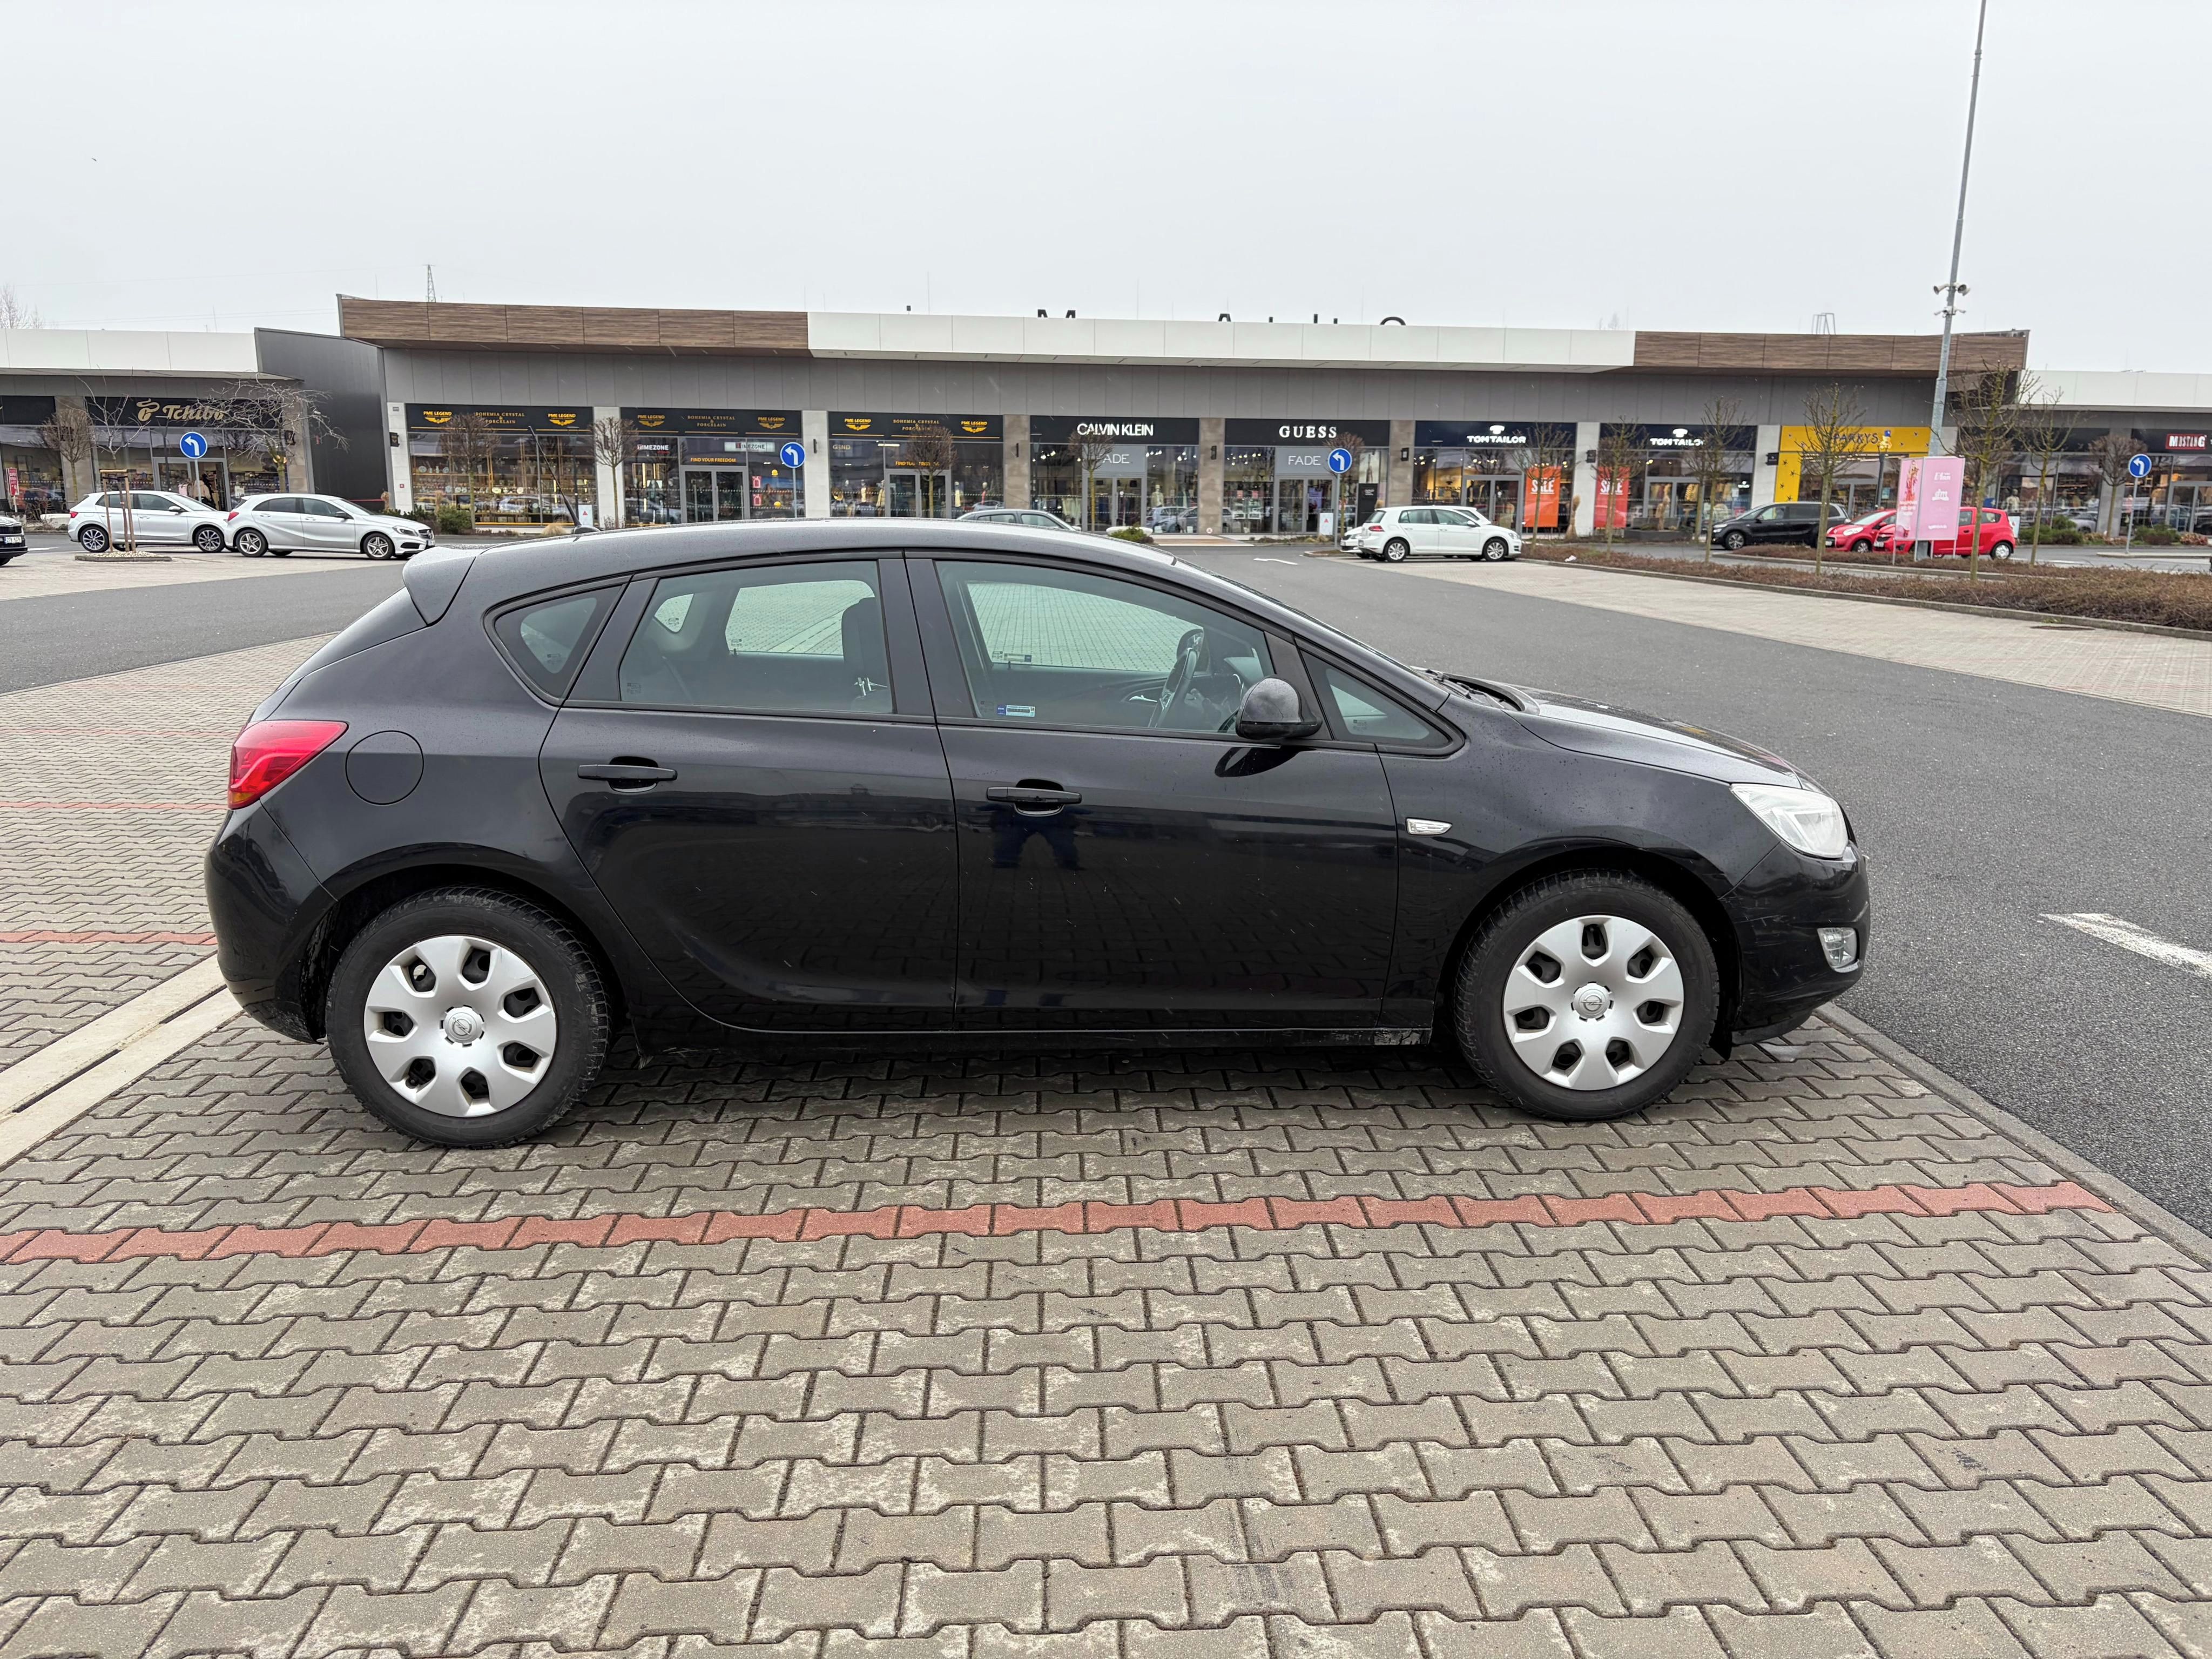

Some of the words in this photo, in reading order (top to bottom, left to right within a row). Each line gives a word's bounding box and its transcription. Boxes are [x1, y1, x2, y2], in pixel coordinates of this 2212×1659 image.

[162, 405, 224, 421] Tchibo
[1077, 423, 1120, 435] CALVIN
[1122, 424, 1154, 436] KLEIN
[1279, 426, 1337, 438] GUESS
[1288, 456, 1321, 466] FADE
[1600, 478, 1624, 494] SE
